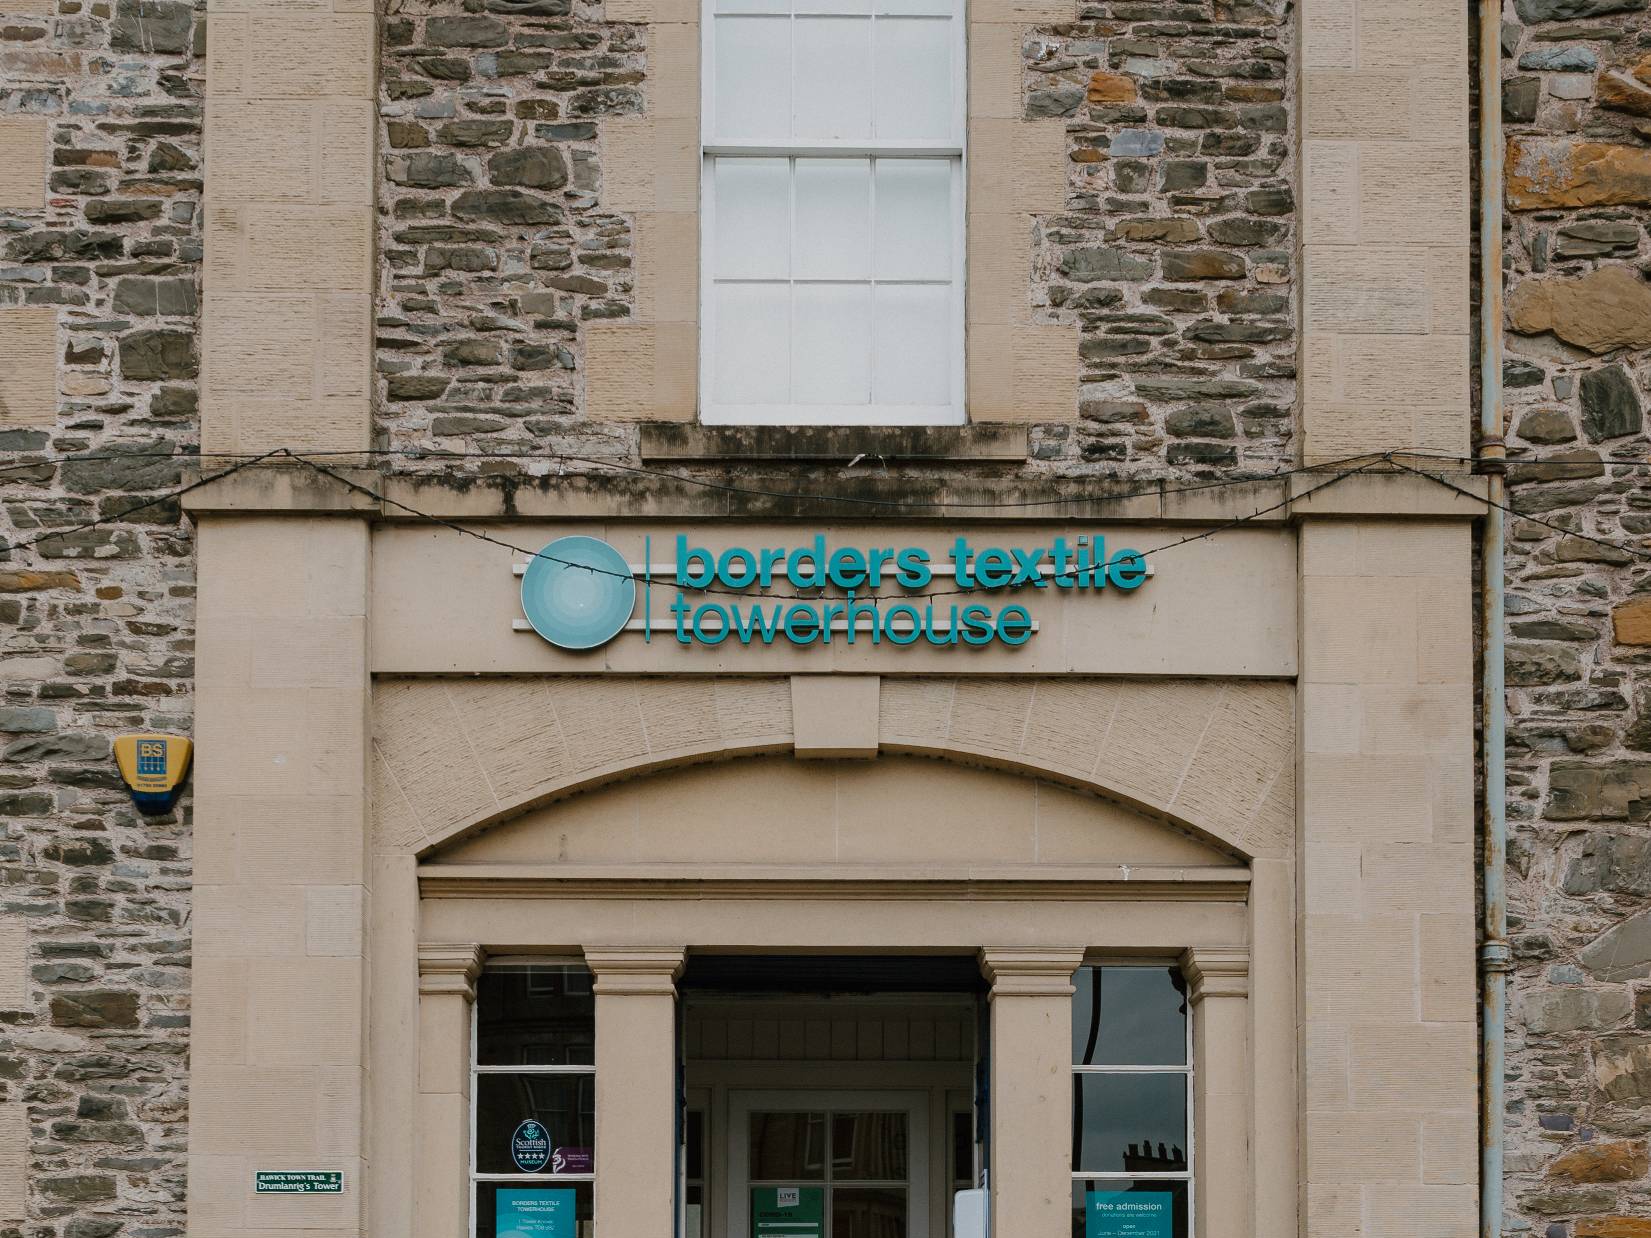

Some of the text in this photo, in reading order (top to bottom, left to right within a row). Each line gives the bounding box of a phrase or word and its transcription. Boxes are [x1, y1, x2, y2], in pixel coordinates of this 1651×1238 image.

[676, 535, 1149, 589] borders textile
[671, 591, 1033, 646] towerhouse
[515, 1138, 547, 1146] Scottish
[258, 1182, 340, 1191] Drumlanrig's Tower
[1096, 1202, 1162, 1210] free admission
